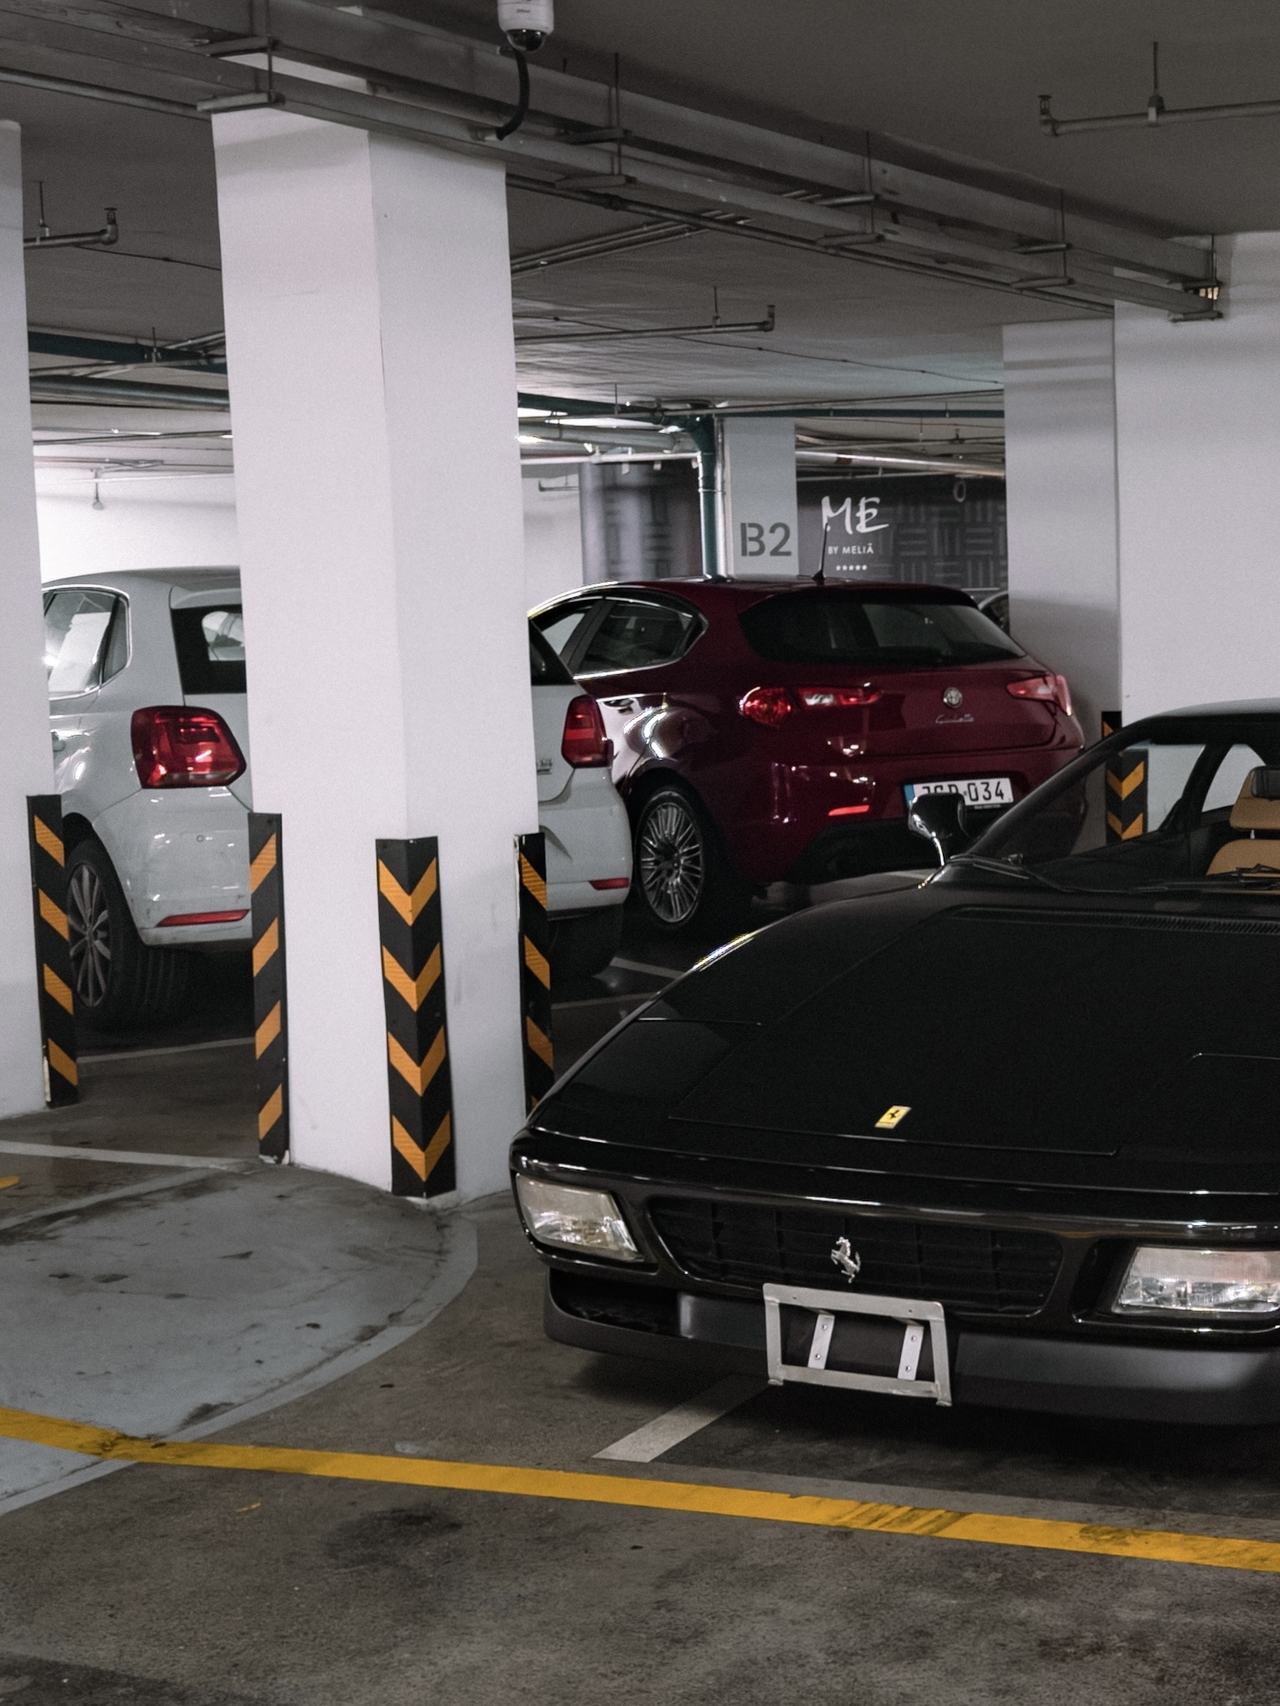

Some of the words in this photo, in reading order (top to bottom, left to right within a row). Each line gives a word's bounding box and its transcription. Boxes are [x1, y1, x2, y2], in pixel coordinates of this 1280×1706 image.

[821, 496, 889, 535] ME
[740, 522, 792, 556] B2
[828, 546, 839, 554] BY
[967, 781, 1004, 802] 034
